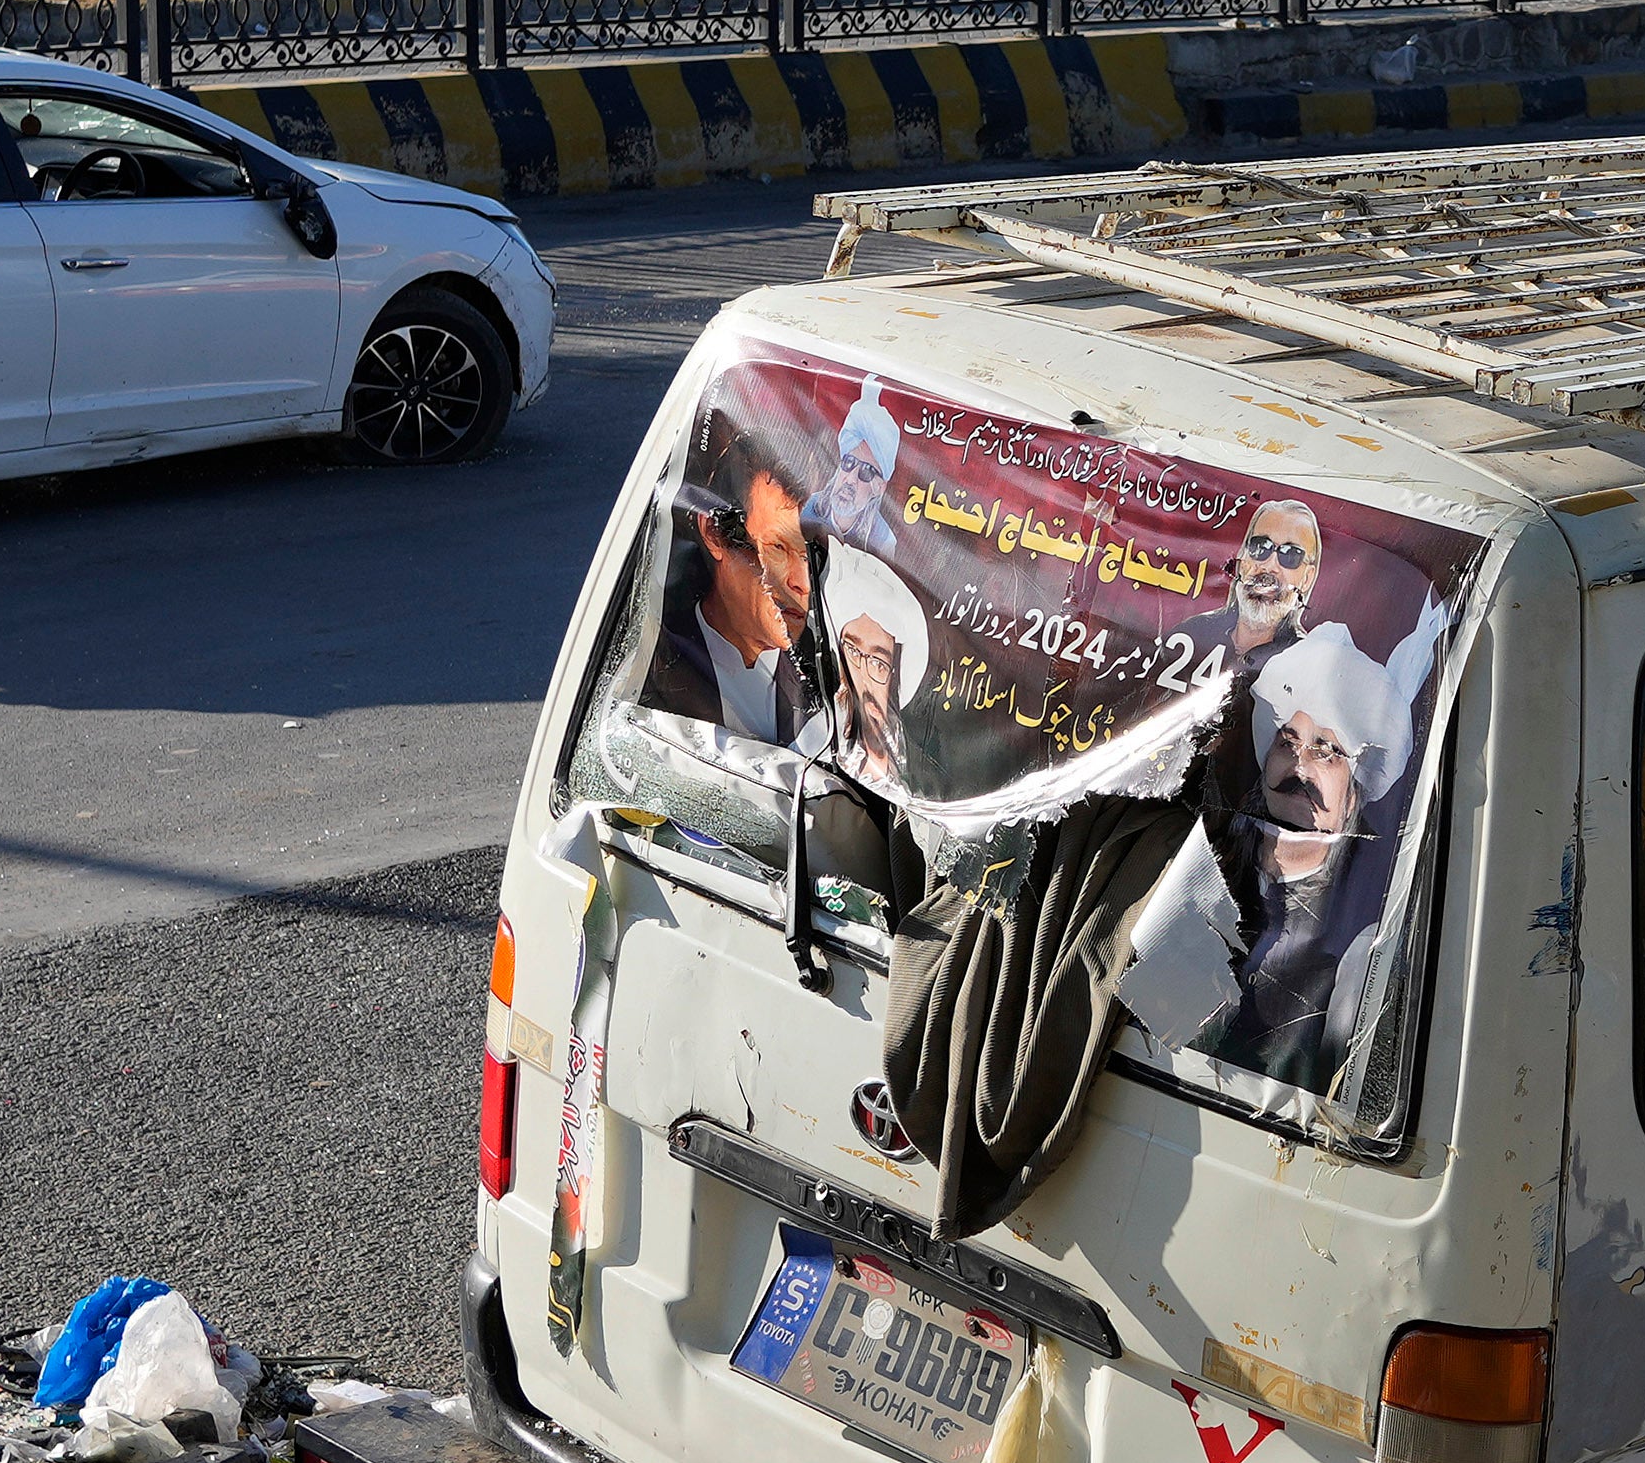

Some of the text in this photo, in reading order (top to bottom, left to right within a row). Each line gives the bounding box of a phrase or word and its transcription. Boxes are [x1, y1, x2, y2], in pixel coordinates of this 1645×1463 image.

[903, 406, 947, 437] خلاف
[942, 411, 966, 446] کے
[962, 417, 1002, 466] ترمیم
[1028, 443, 1050, 470] اور
[1050, 442, 1121, 484] گرفتاری
[1144, 463, 1179, 507] کی
[1163, 481, 1198, 513] خان
[1196, 491, 1248, 529] عمران
[903, 479, 1209, 600] احتجاج احتجاج احتجاج
[1017, 607, 1110, 671] 2024
[1095, 635, 1164, 682] نومبر
[1155, 632, 1228, 694] 24
[1014, 678, 1075, 752] چوک
[792, 1174, 964, 1276] TOYOTA
[781, 1279, 812, 1311] S
[907, 1285, 947, 1317] KPK
[756, 1317, 796, 1349] TOYOTA
[874, 1305, 1013, 1426] 9689
[853, 1375, 935, 1434] KOHAT
